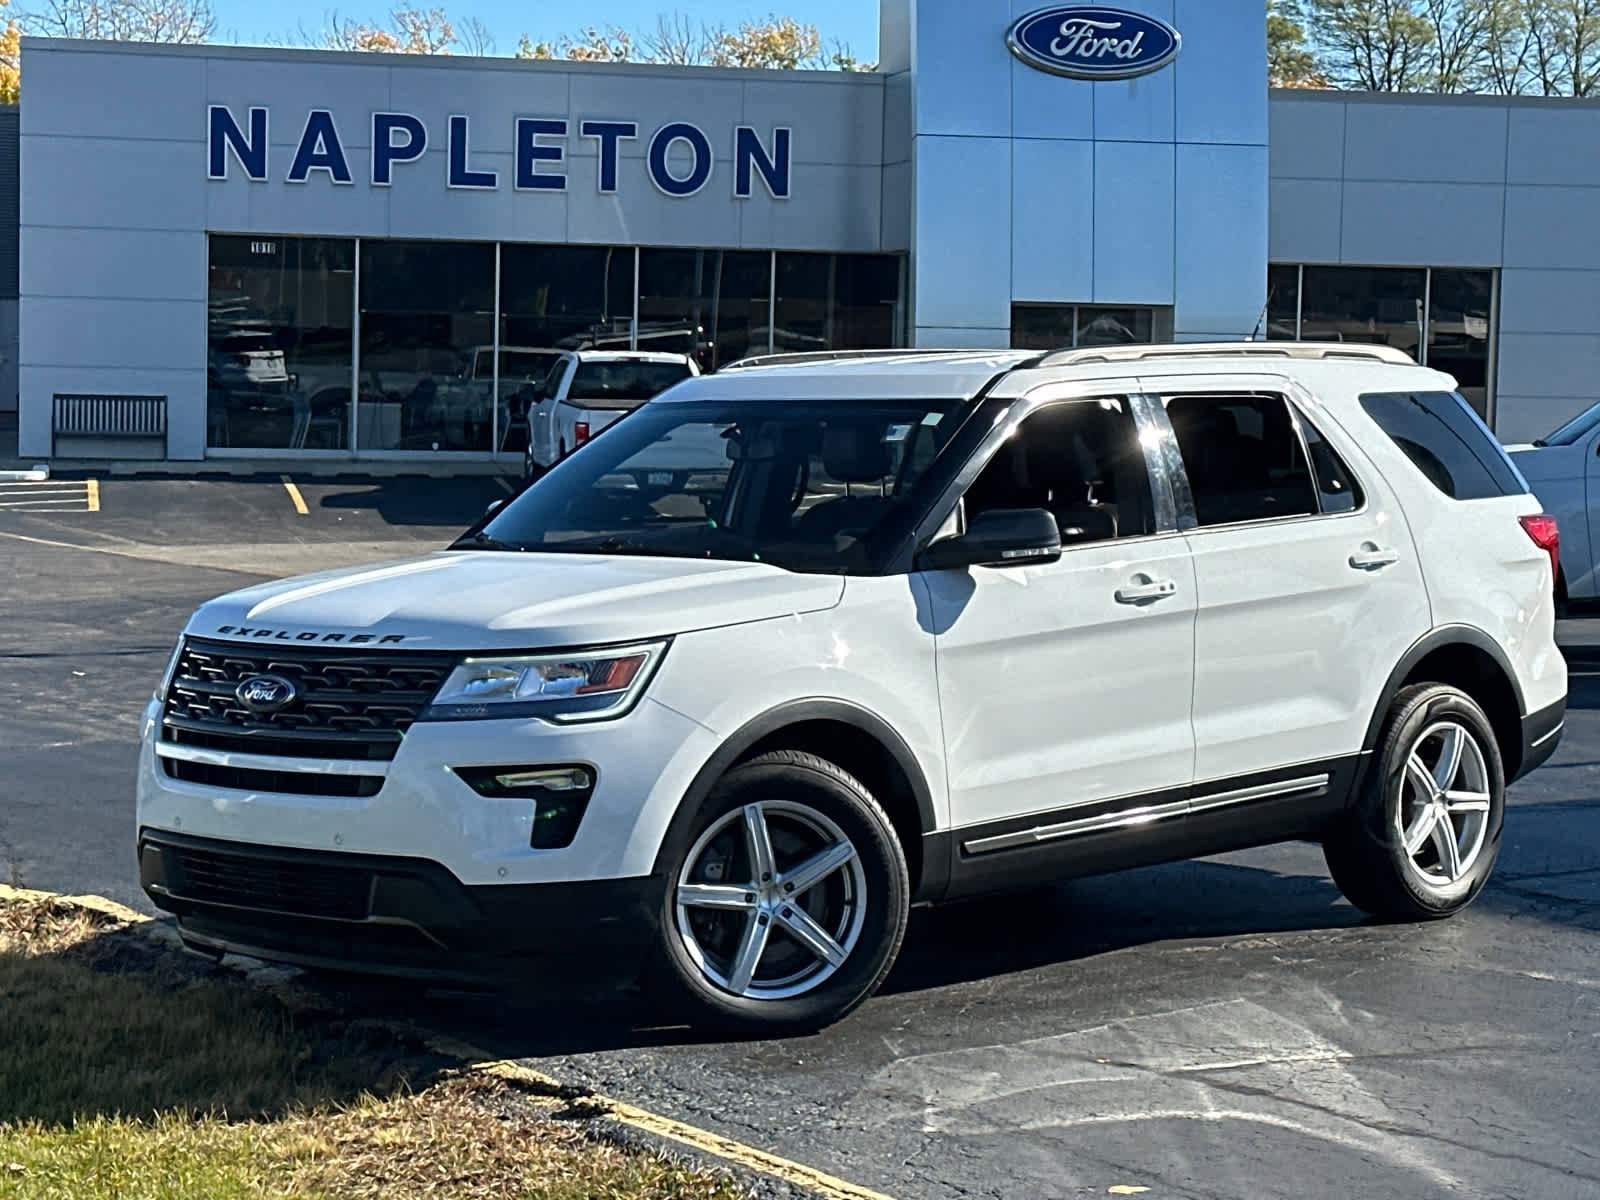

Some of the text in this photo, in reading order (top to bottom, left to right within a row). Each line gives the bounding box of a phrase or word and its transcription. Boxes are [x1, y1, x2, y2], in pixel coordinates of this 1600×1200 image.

[1050, 18, 1144, 59] Ford
[207, 104, 792, 200] NAPLETON
[217, 625, 406, 644] EXPLORER
[244, 680, 278, 701] Ford
